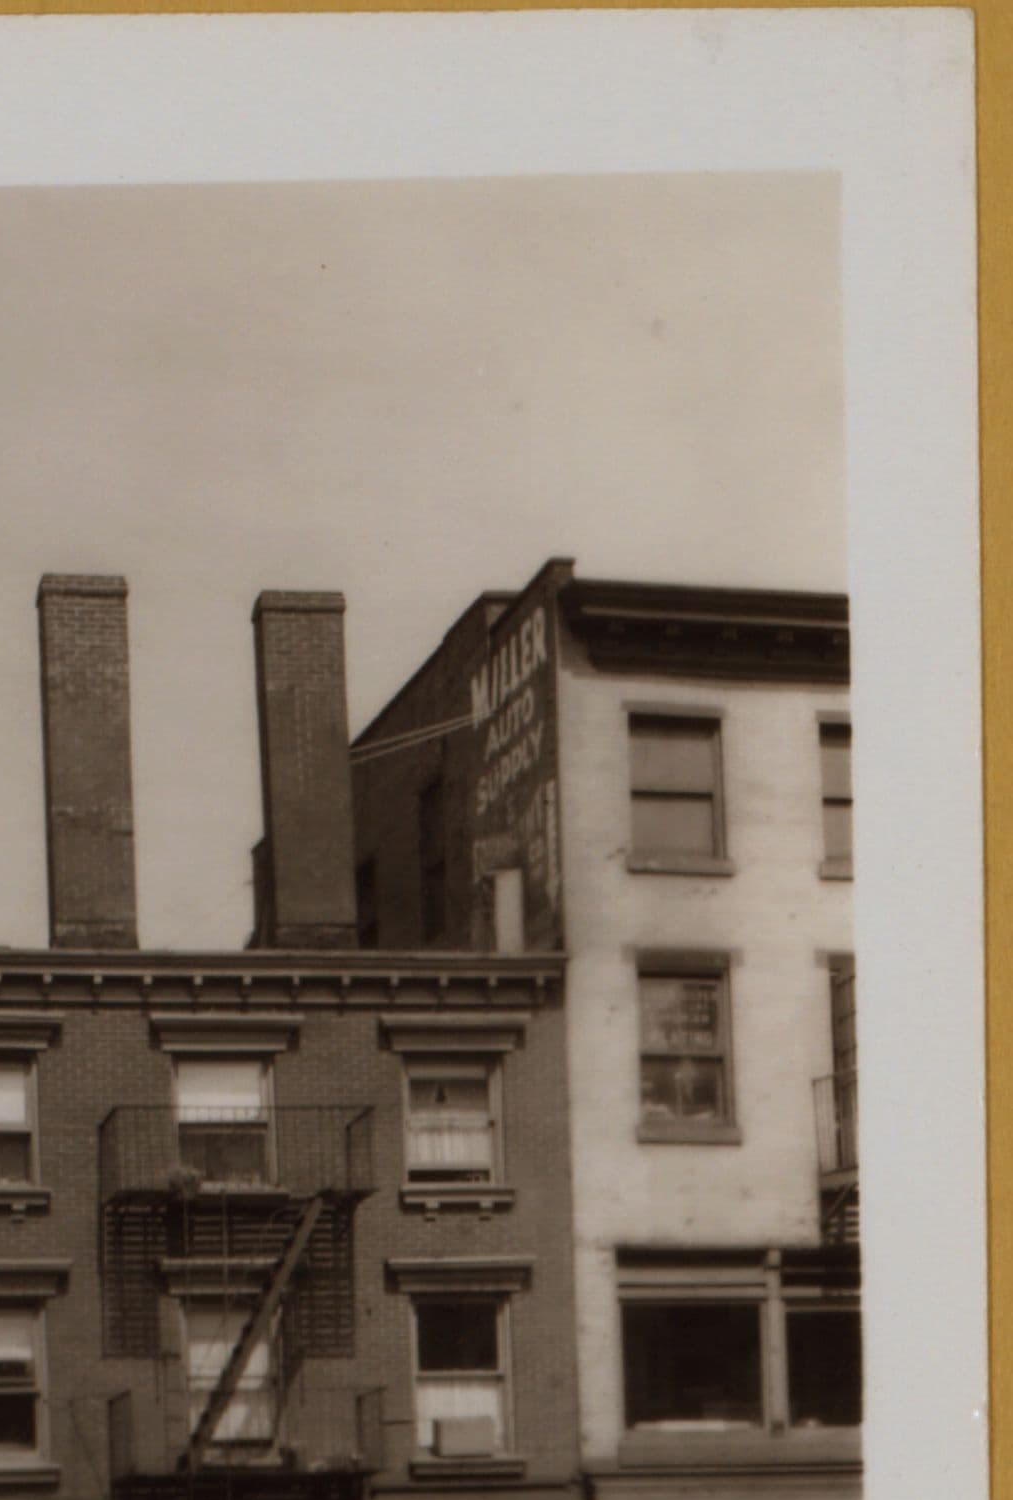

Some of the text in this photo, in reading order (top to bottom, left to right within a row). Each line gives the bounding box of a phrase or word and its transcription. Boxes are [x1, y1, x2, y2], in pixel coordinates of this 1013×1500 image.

[471, 605, 547, 731] MILLER
[476, 720, 544, 816] SUPPLY
[485, 687, 535, 762] AUTO
